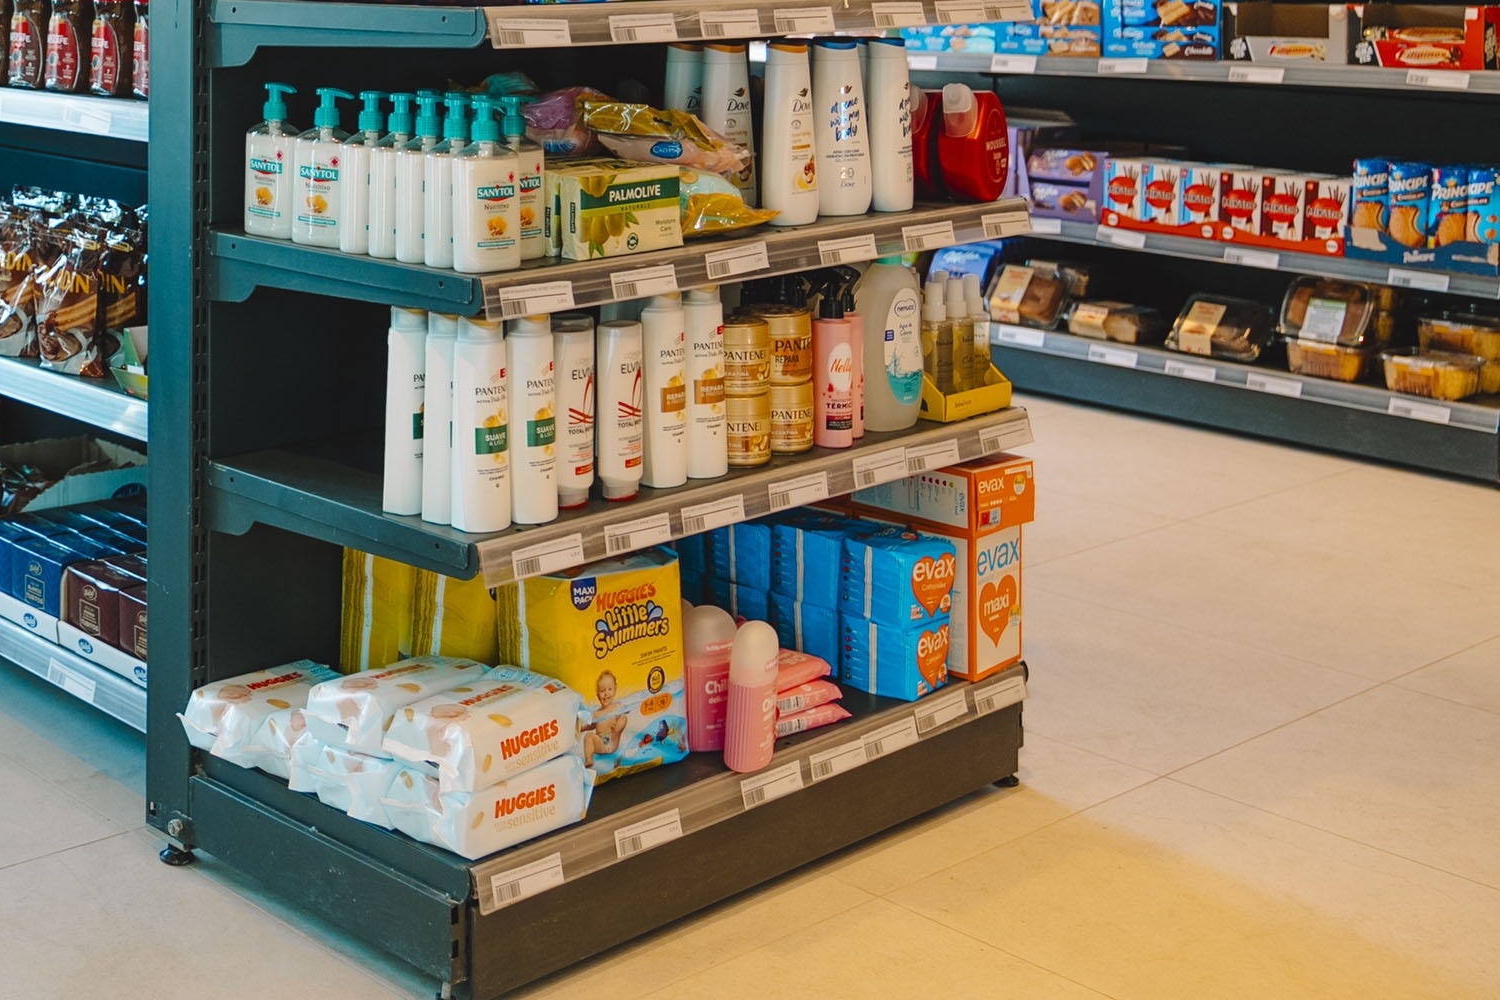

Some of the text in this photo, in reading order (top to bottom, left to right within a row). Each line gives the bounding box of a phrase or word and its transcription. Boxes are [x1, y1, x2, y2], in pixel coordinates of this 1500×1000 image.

[727, 98, 749, 112] Dove
[250, 160, 282, 173] SANYTOL
[300, 166, 338, 181] SANYTOL
[477, 186, 515, 199] SANYTOL
[609, 184, 661, 203] PALMOLIVE
[620, 202, 651, 211] NATURALS
[660, 225, 672, 233] Care
[724, 350, 765, 361] PANTENE
[771, 407, 812, 420] PANTENE
[728, 421, 760, 433] NTENE
[485, 432, 506, 442] SUAVE
[978, 476, 1004, 494] evax
[977, 537, 1020, 576] evax
[913, 556, 956, 582] evax
[573, 586, 595, 597] MAXI
[574, 595, 594, 605] PACK
[596, 582, 656, 612] HUGGIES
[984, 588, 1010, 617] maxi
[605, 602, 649, 632] Little
[593, 618, 669, 659] Swimmers
[917, 625, 949, 658] evax
[247, 671, 303, 692] HUGGIES
[500, 719, 559, 760] HUGGIES
[515, 740, 560, 769] sensitive
[494, 783, 556, 818] HUGGIES
[506, 805, 556, 829] sensitive
